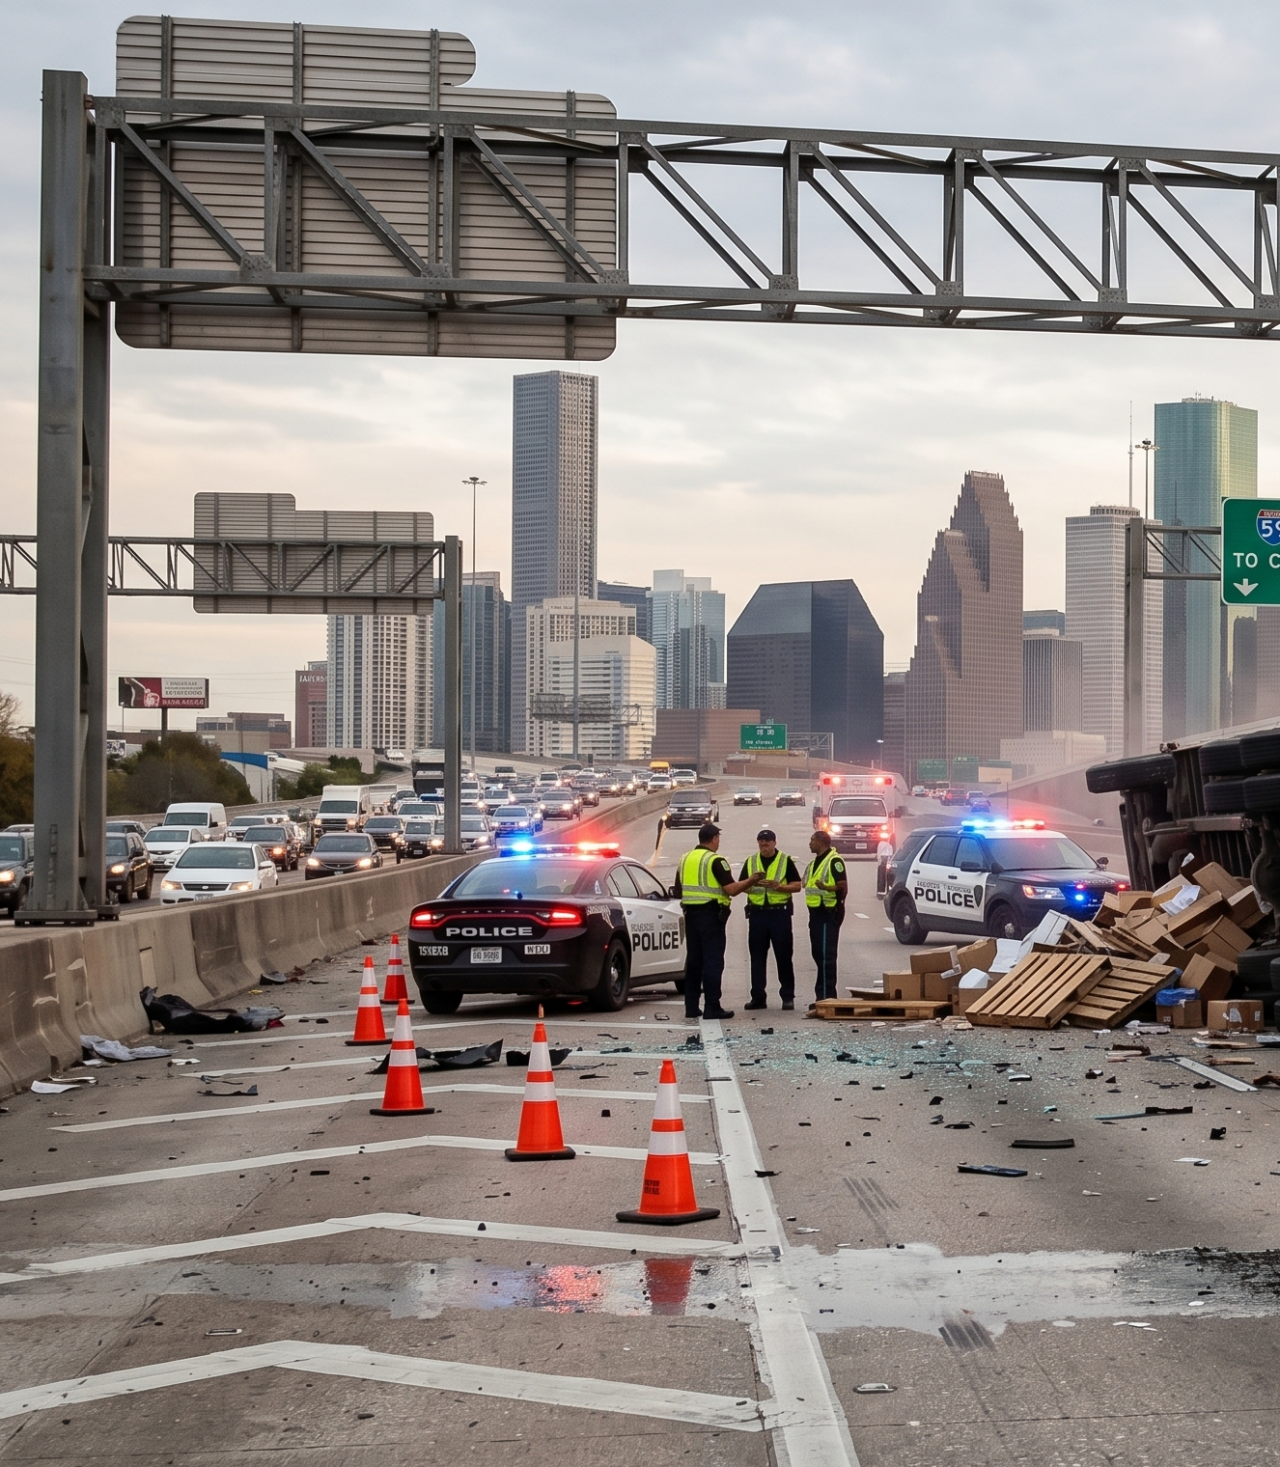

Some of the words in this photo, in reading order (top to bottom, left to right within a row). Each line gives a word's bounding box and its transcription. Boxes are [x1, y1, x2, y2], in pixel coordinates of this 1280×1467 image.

[1233, 552, 1259, 569] TO
[914, 886, 975, 909] POLICE
[446, 926, 533, 937] POLICE
[632, 930, 680, 952] POLICE
